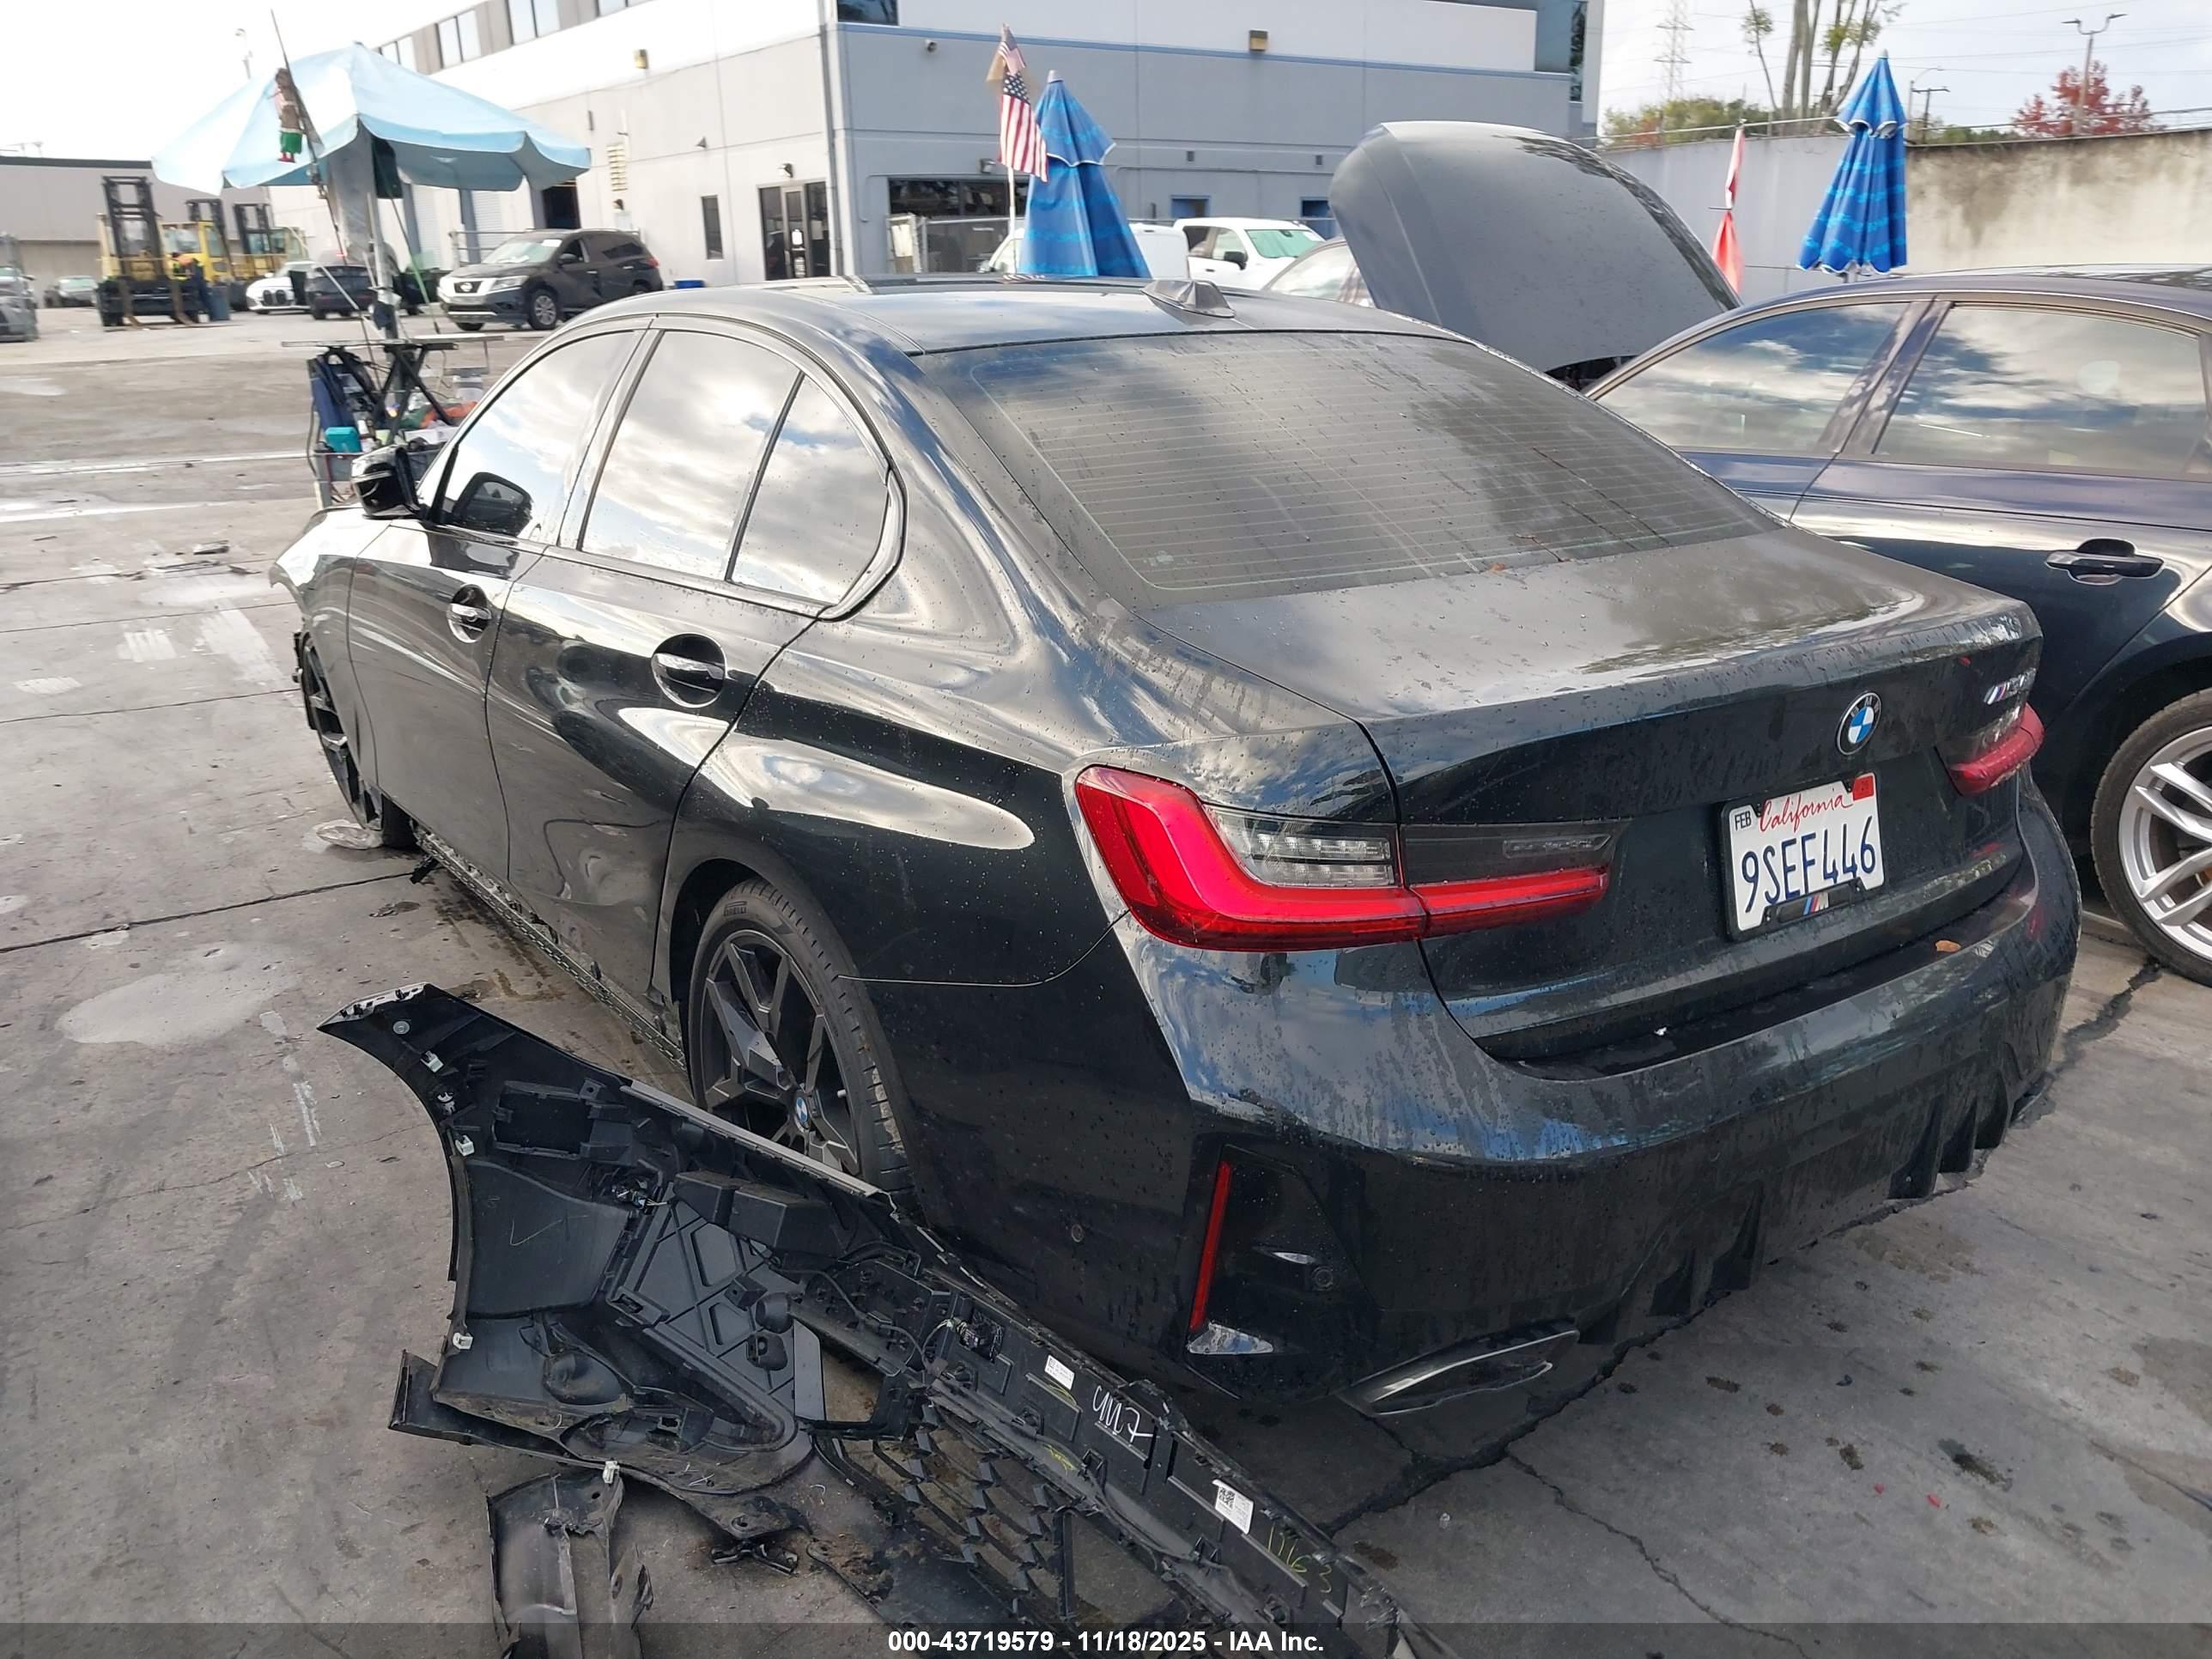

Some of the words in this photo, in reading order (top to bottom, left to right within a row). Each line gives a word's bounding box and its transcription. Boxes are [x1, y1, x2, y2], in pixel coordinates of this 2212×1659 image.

[1735, 811, 1752, 831] FEB
[1759, 787, 1853, 833] California
[1741, 815, 1876, 914] 9SEF446
